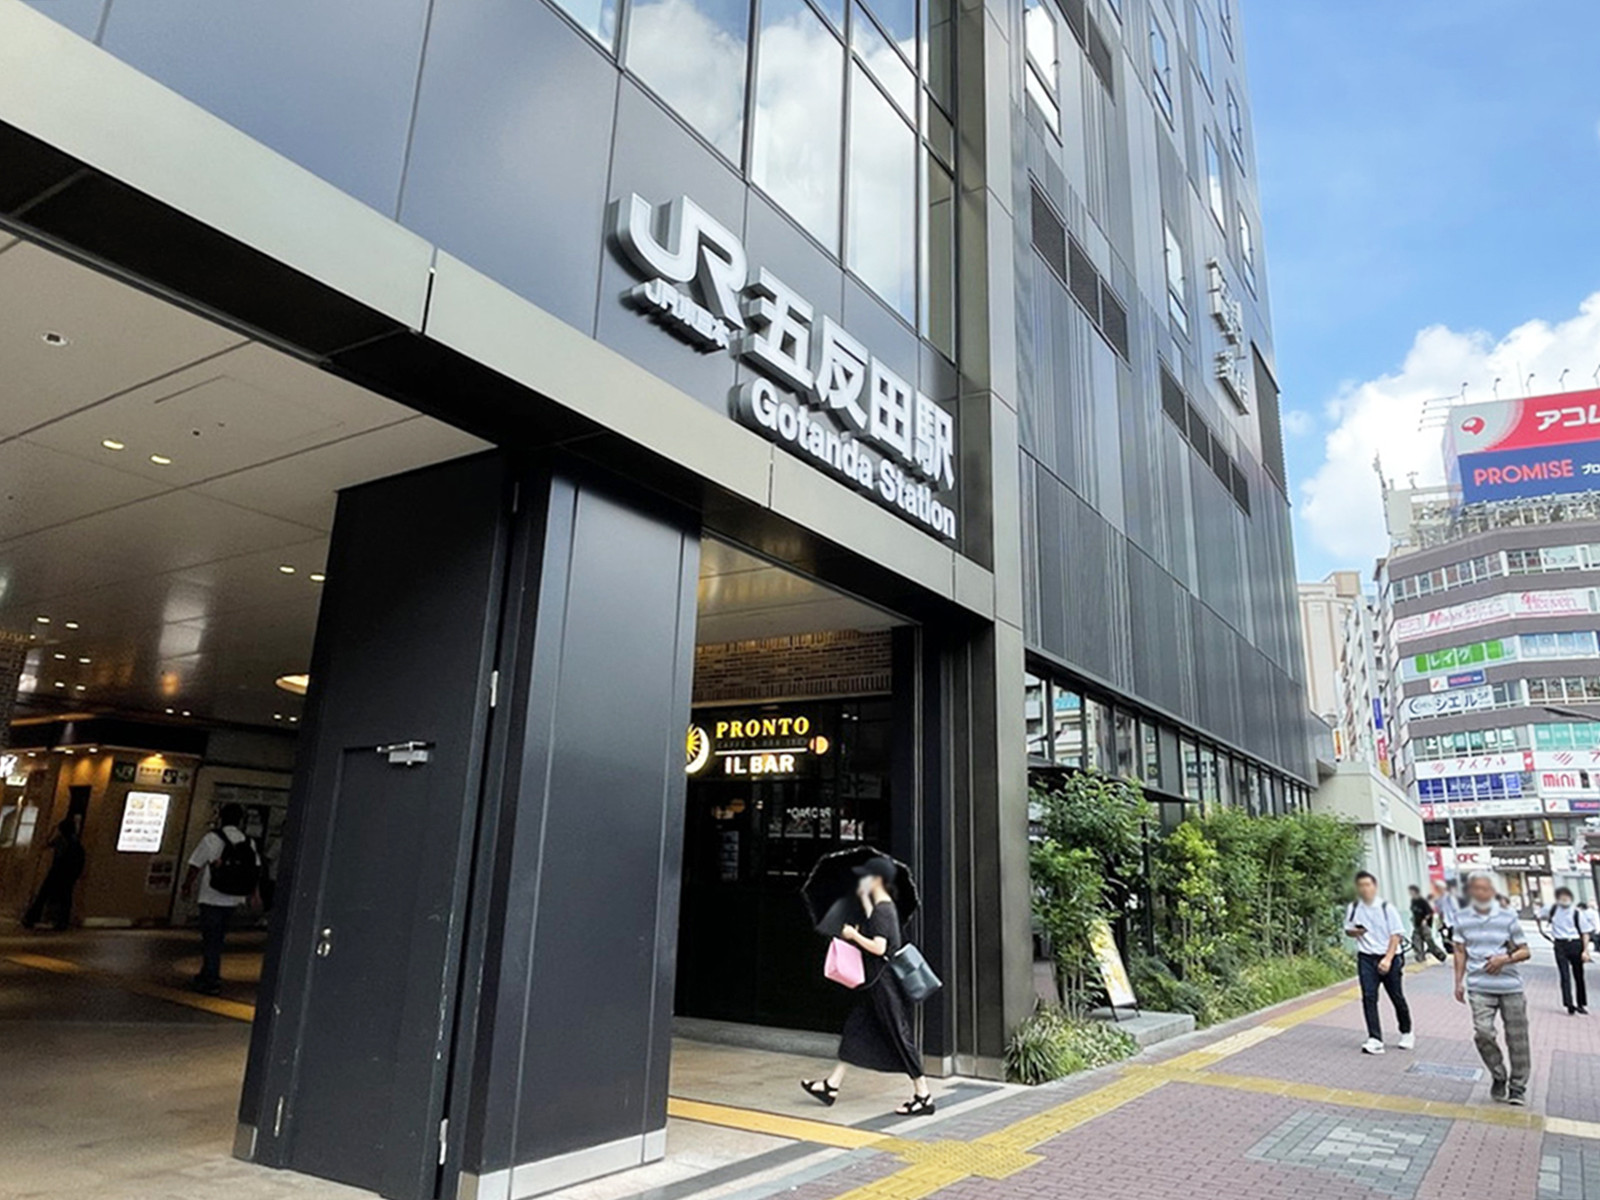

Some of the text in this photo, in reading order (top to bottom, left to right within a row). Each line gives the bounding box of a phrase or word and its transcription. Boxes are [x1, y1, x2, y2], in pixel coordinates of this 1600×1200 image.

[627, 192, 955, 490] JR 五反田駅
[751, 377, 957, 541] Gotanda Station
[1474, 459, 1575, 487] PROMISE
[1430, 648, 1472, 668] レイク
[1436, 694, 1478, 711] シエル
[715, 716, 810, 739] PRONTO
[725, 754, 795, 775] IL BAR
[1542, 773, 1576, 788] mini
